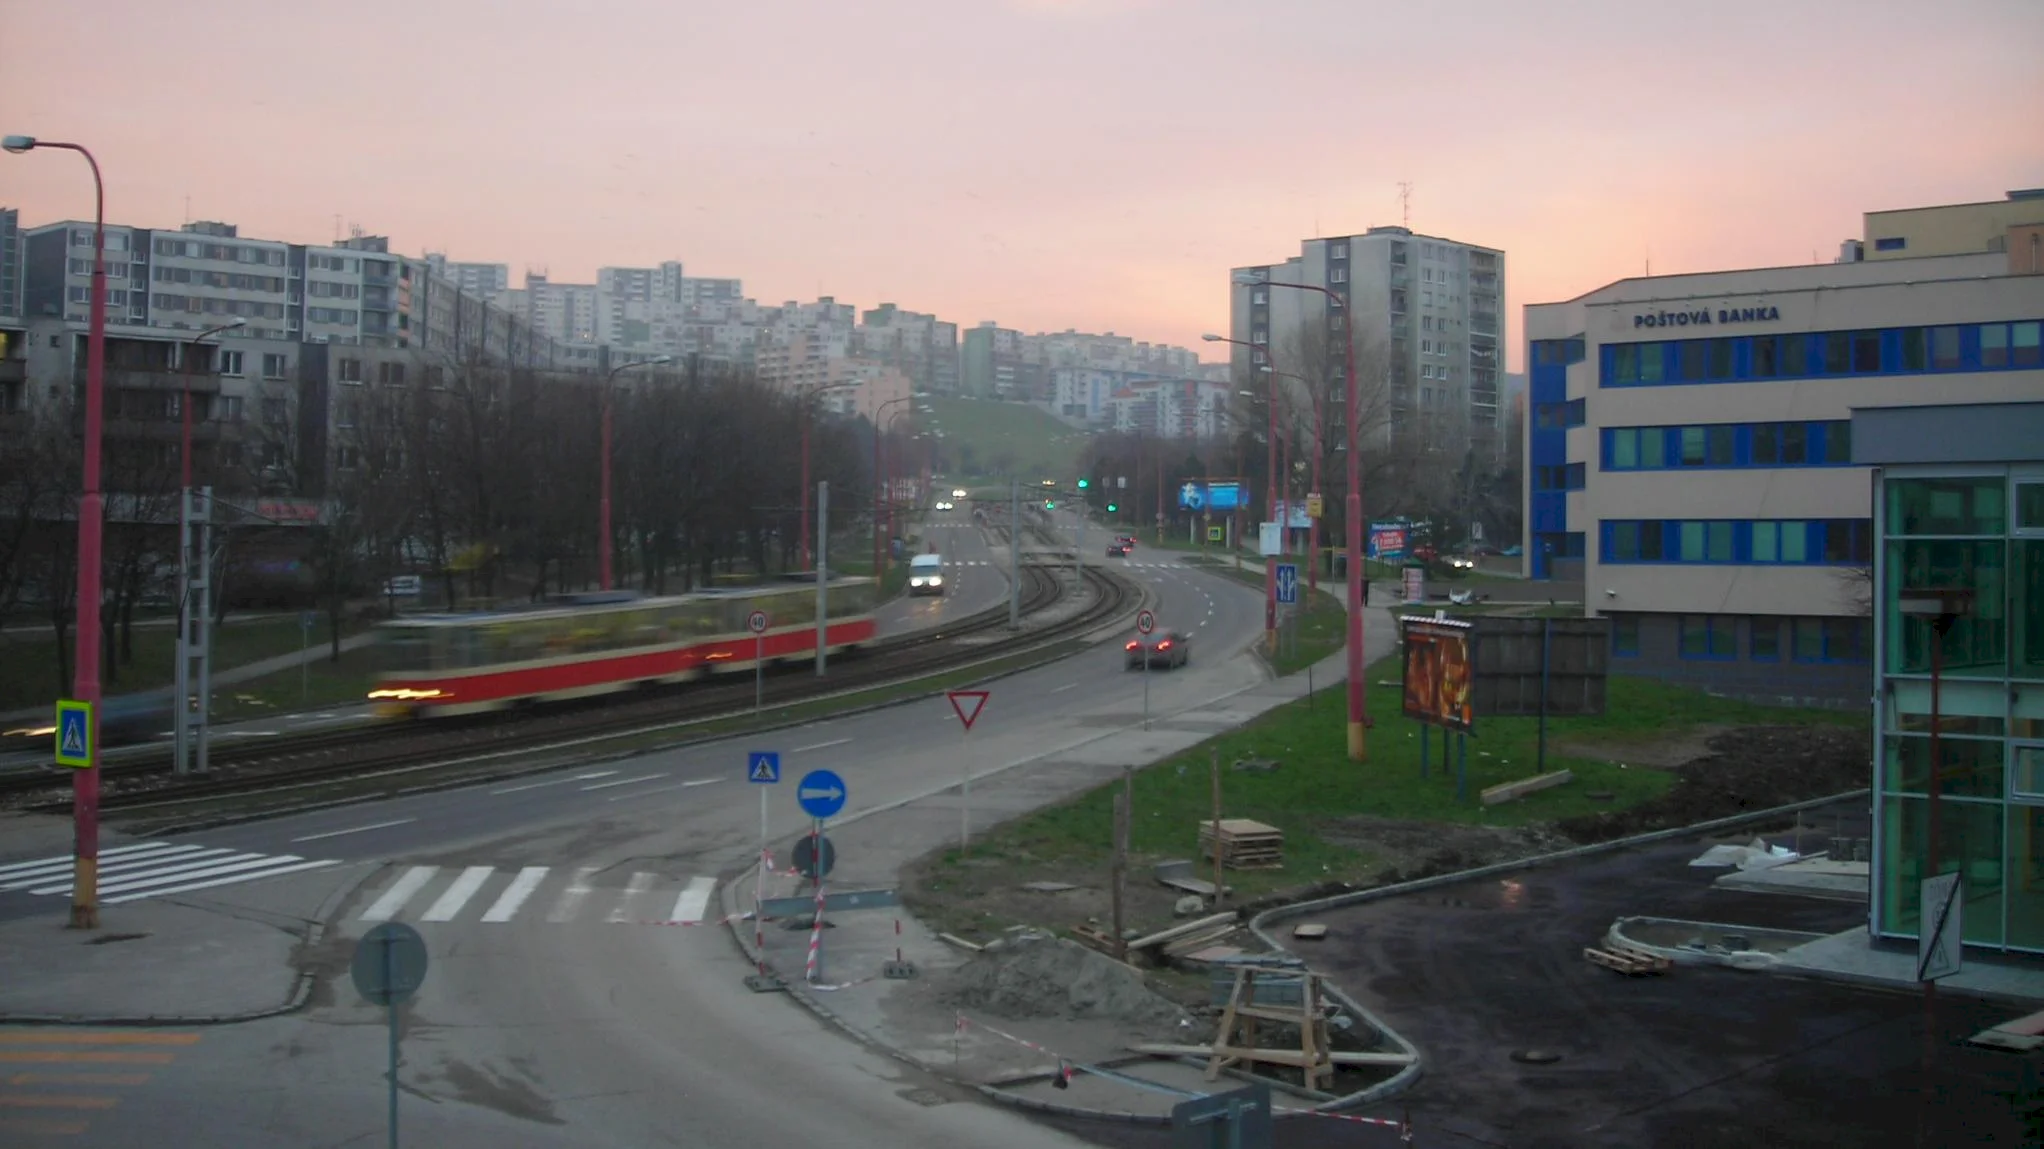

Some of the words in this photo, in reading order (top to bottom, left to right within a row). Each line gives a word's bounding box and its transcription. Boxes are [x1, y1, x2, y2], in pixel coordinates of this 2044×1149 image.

[1634, 307, 1711, 327] POŠTOVÁ
[1718, 306, 1779, 324] BANKA
[752, 616, 763, 628] 40
[1140, 616, 1150, 628] 40
